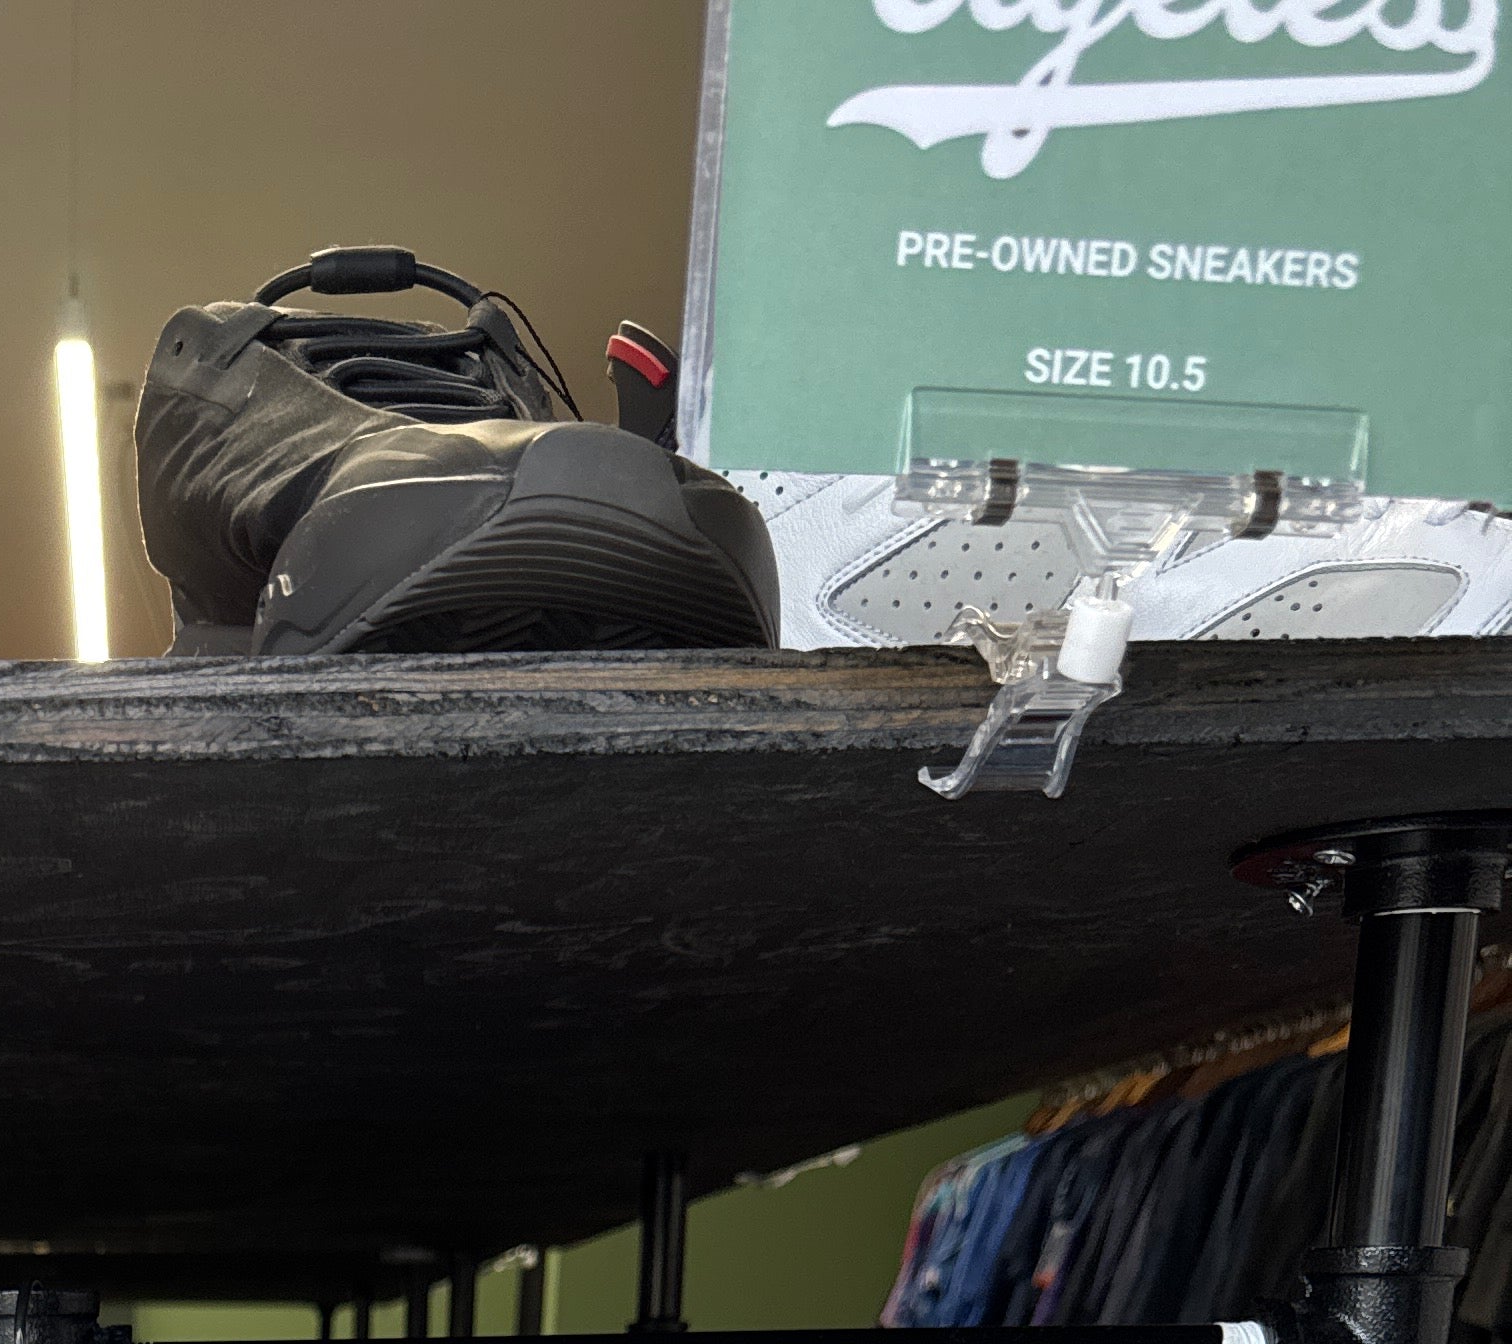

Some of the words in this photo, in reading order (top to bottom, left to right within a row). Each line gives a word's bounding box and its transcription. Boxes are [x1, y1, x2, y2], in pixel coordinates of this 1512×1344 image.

[895, 230, 1138, 278] PRE-OWNED
[1145, 243, 1361, 291] SNEAKERS
[1022, 347, 1115, 389] SIZE
[1124, 354, 1209, 393] 10.5
